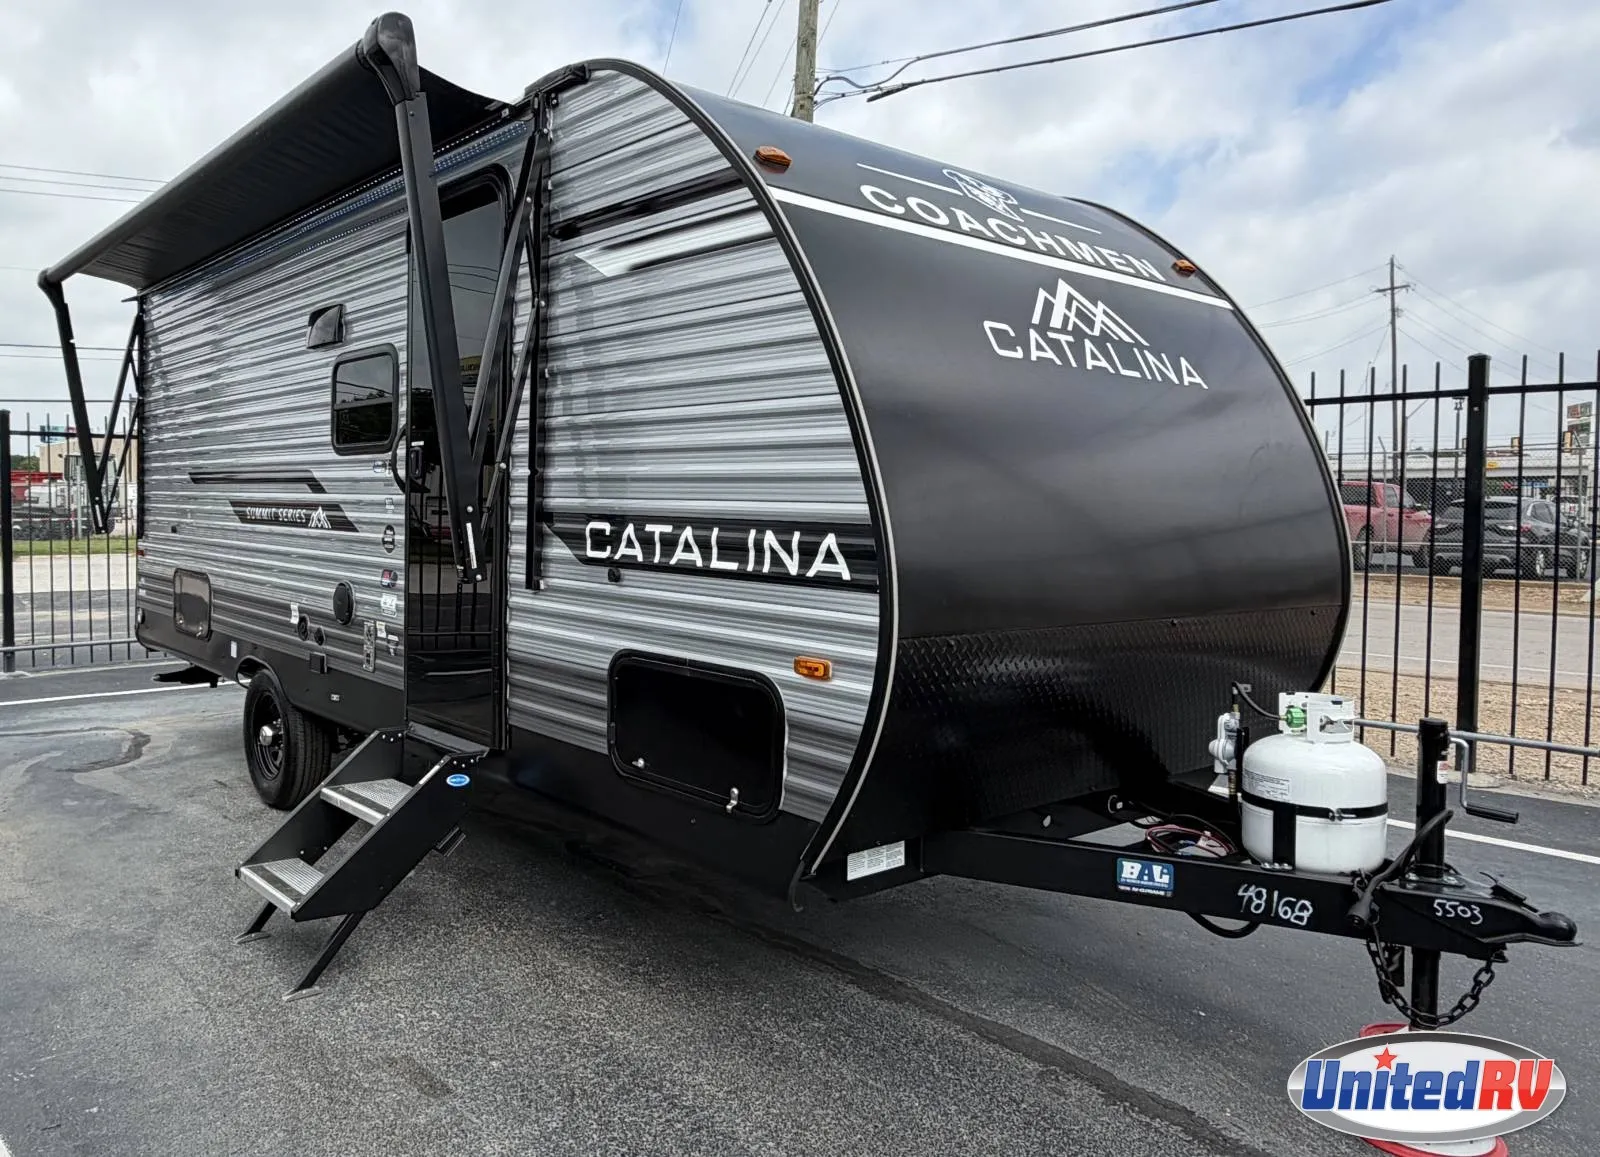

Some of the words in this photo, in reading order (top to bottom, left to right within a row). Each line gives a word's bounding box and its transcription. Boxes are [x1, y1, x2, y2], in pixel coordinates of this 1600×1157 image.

[860, 184, 1166, 281] COACHMEN
[983, 320, 1208, 389] CATALINA
[246, 507, 275, 520] SUMMIT
[278, 508, 306, 522] SERIES
[585, 521, 851, 580] CATALINA
[1237, 883, 1313, 926] 48168
[1432, 899, 1483, 925] 5503
